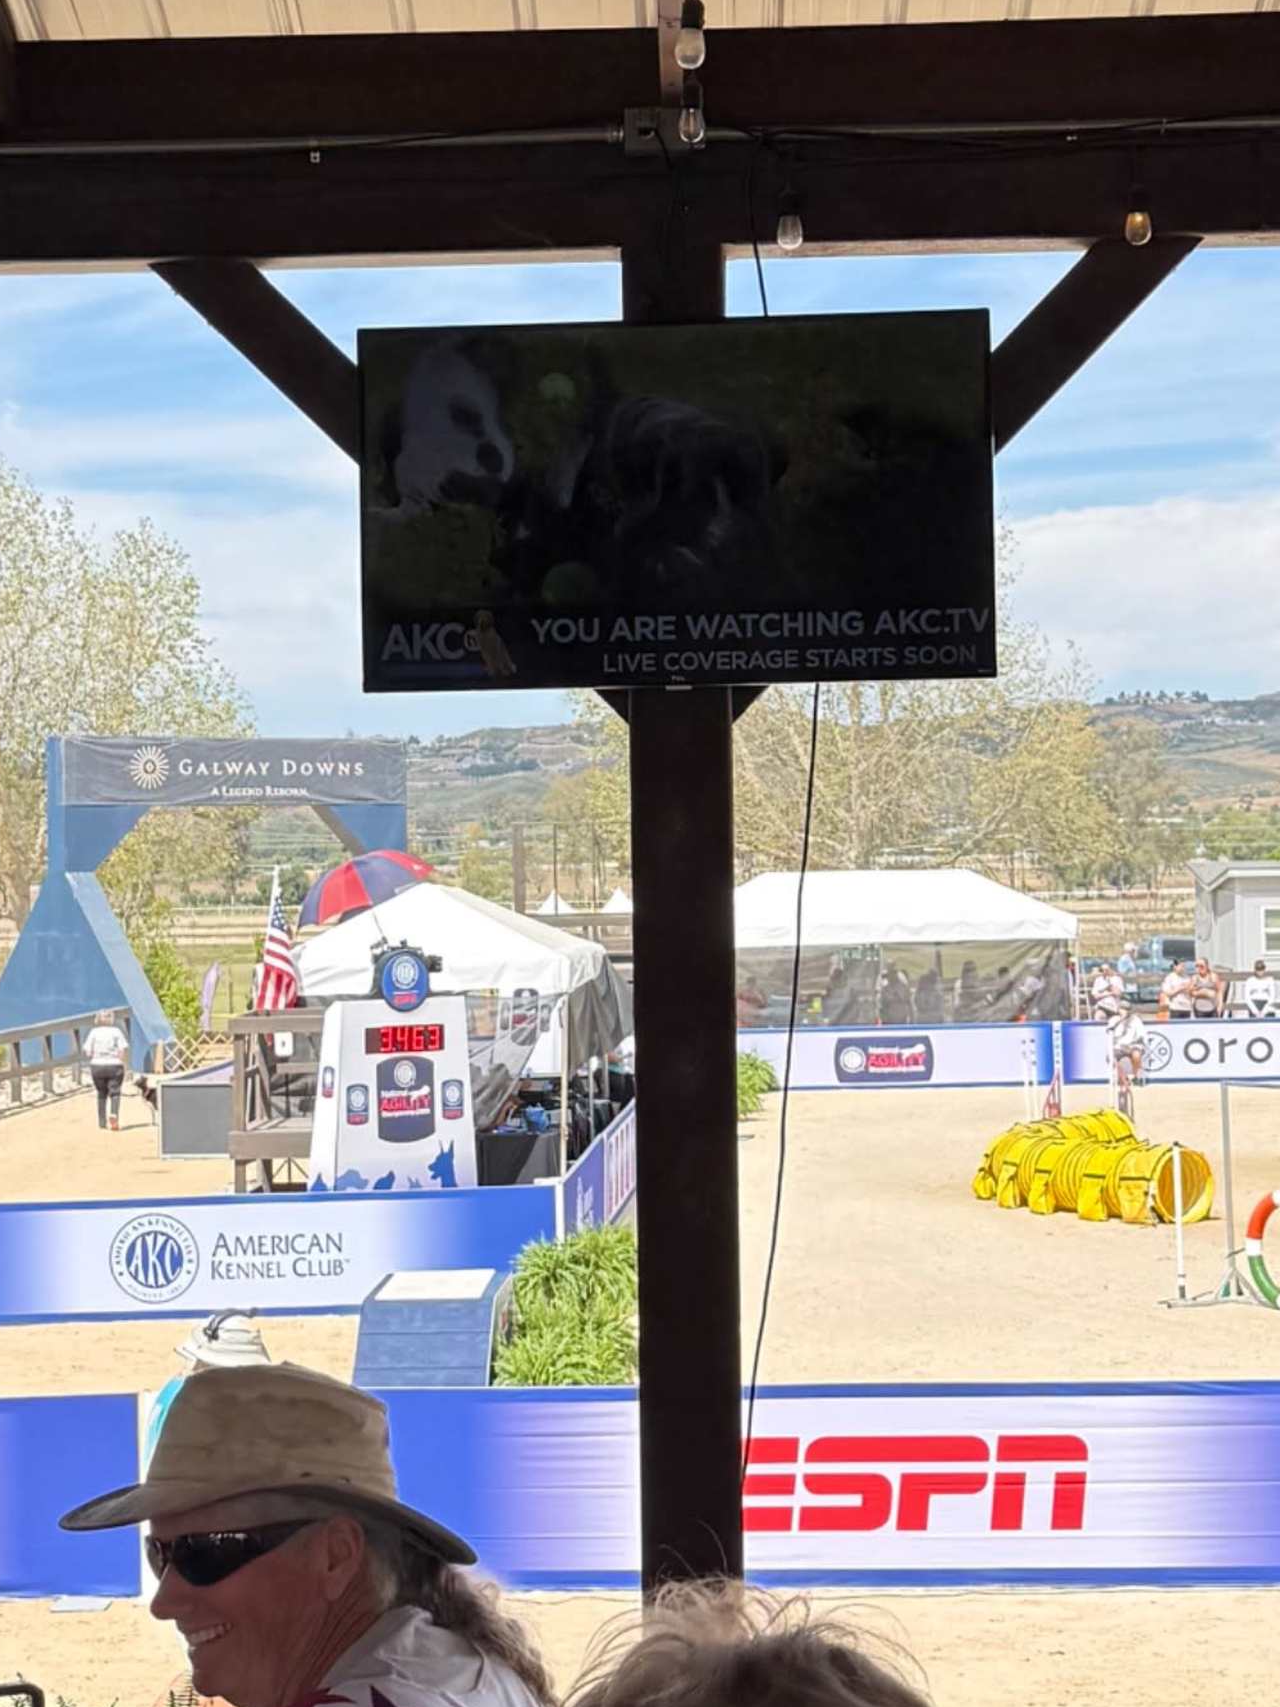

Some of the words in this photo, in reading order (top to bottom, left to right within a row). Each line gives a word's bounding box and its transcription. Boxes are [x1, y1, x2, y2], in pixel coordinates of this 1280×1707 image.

[531, 618, 599, 643] YOU
[610, 615, 677, 642] ARE
[685, 611, 865, 640] WATCHING
[874, 608, 989, 635] AKC.TV
[381, 623, 465, 661] AKC
[603, 653, 657, 672] LIVE
[664, 649, 799, 671] COVERAGE
[805, 646, 897, 668] STARTS
[904, 645, 976, 665] SOON
[178, 759, 270, 776] GALWAY
[283, 759, 364, 776] DOWNS
[129, 1233, 182, 1287] AKC
[211, 1233, 343, 1257] AMERICAN
[211, 1260, 285, 1280] KENNEL
[742, 1434, 1089, 1532] ESPN
